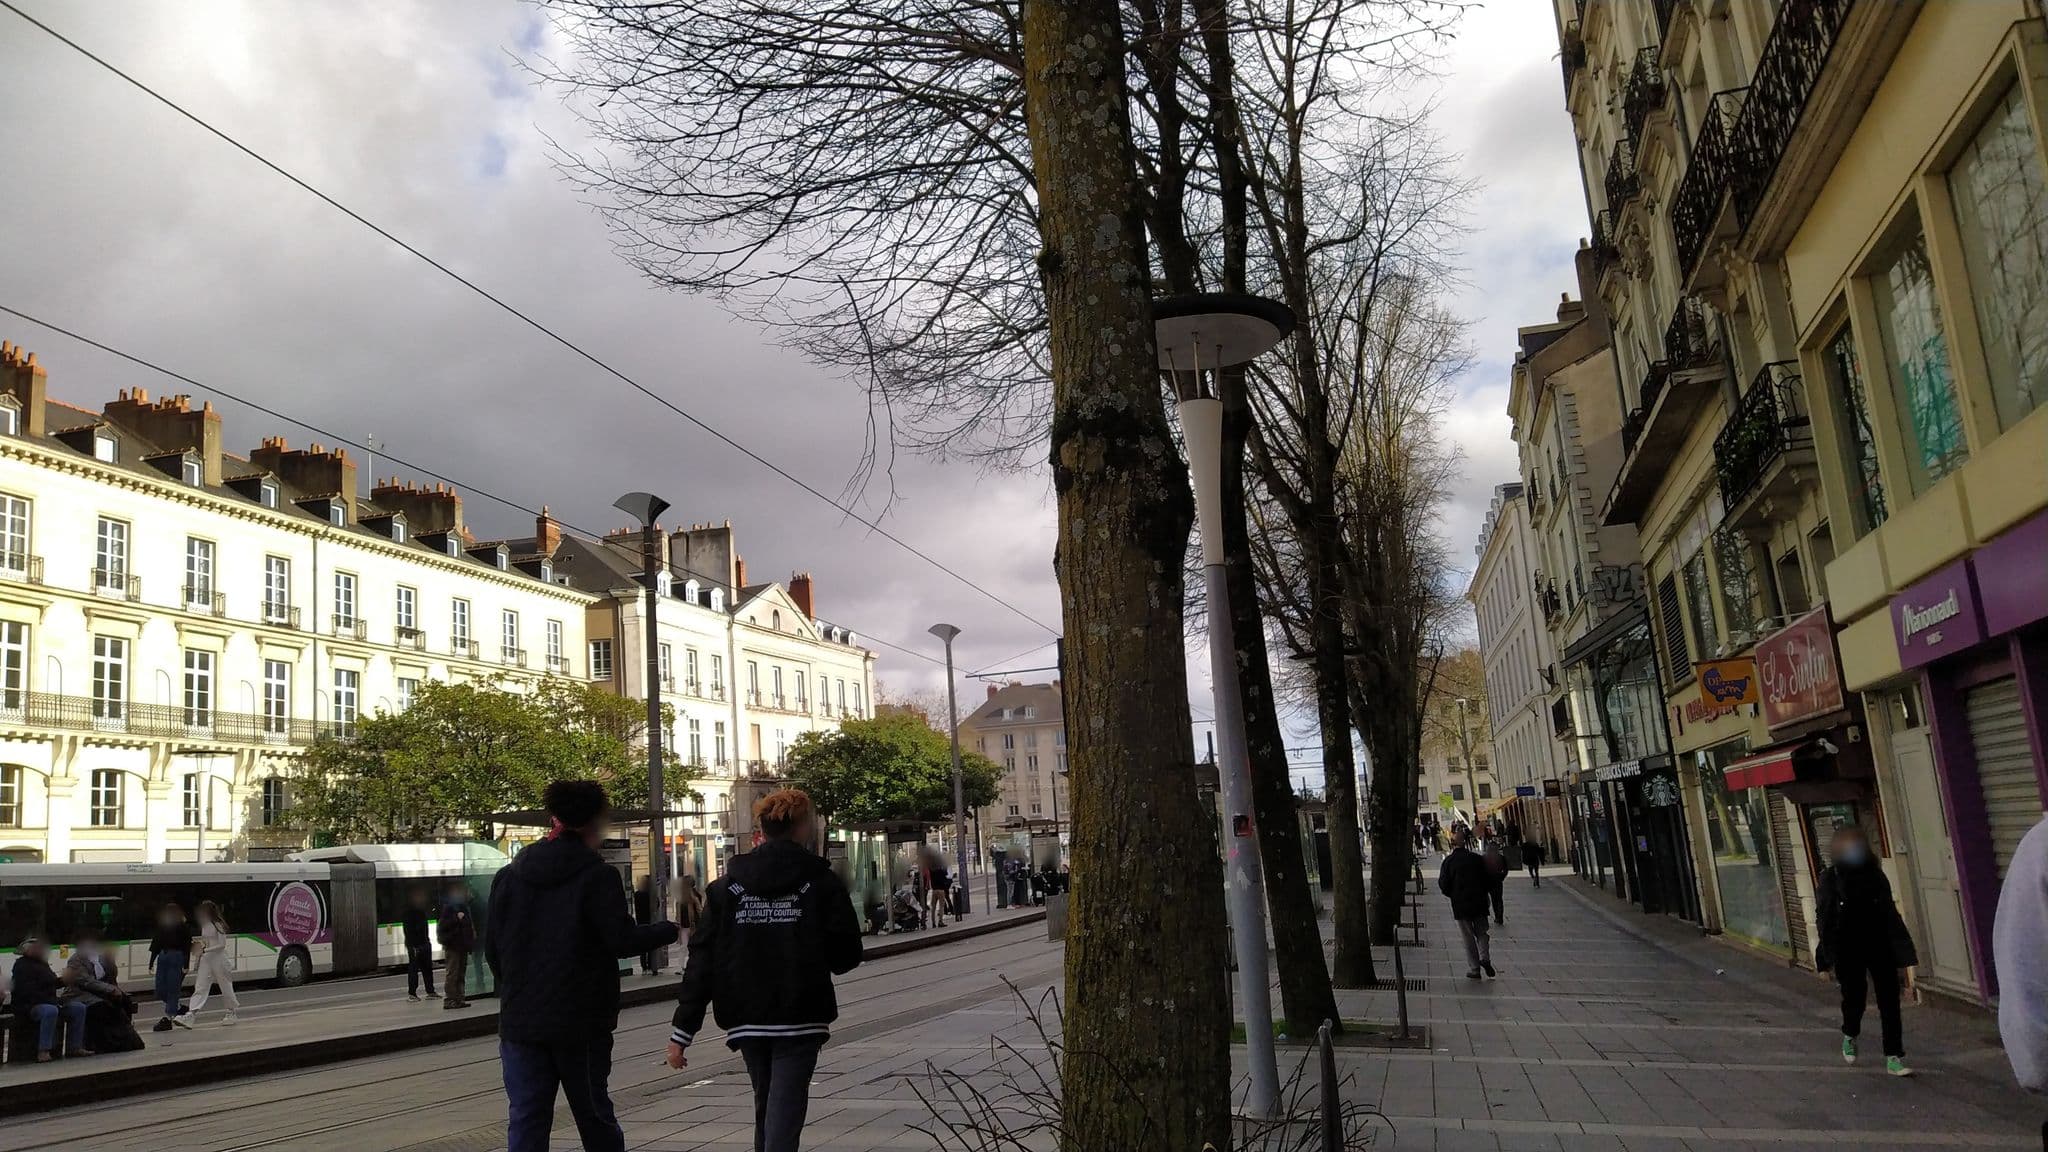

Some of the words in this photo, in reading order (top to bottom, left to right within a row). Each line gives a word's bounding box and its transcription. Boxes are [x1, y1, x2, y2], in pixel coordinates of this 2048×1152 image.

[1763, 651, 1786, 704] Le
[1595, 763, 1621, 782] STARBUCKS
[1621, 760, 1641, 777] COFFEE
[735, 911, 747, 919] AND
[747, 909, 773, 917] QUALITY
[774, 909, 802, 917] COUTURE
